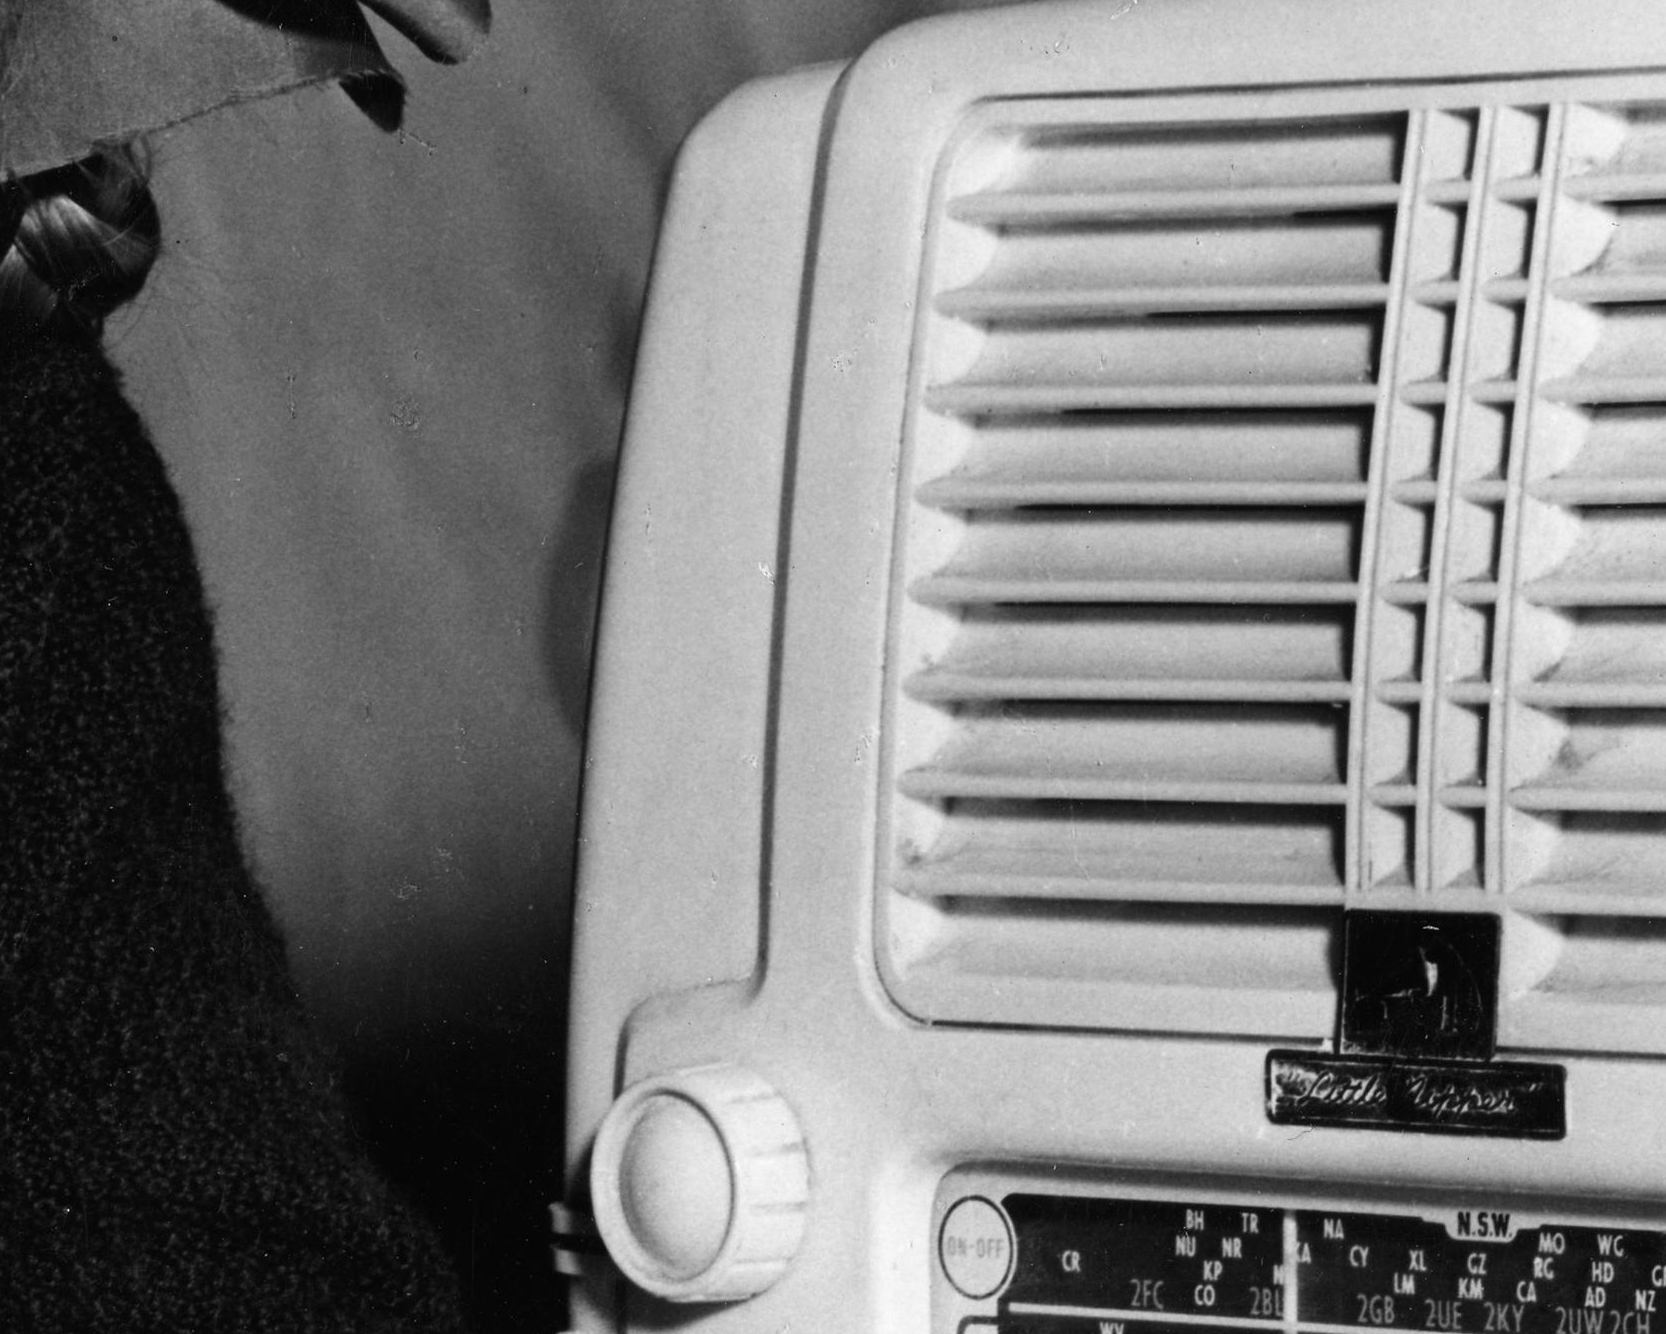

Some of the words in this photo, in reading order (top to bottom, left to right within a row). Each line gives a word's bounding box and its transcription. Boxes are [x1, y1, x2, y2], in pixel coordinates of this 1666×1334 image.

[1186, 1209, 1204, 1231] BH
[1241, 1212, 1259, 1234] TR
[1324, 1219, 1344, 1239] NA
[1457, 1211, 1512, 1239] N.S.W.
[946, 1235, 1004, 1259] ON-OFF
[1175, 1235, 1196, 1257] NU
[1222, 1237, 1242, 1259] NR
[1539, 1233, 1565, 1255] MO
[1597, 1234, 1624, 1257] WG
[1062, 1251, 1081, 1272] CR
[1350, 1245, 1369, 1267] CY
[1409, 1250, 1427, 1272] XL
[1468, 1253, 1487, 1275] GZ
[1203, 1260, 1222, 1281] KP
[1533, 1256, 1554, 1280] RG
[1592, 1261, 1614, 1283] HD
[1394, 1272, 1415, 1294] LM
[1458, 1278, 1484, 1300] KM
[1516, 1281, 1537, 1303] CA
[1130, 1279, 1164, 1310] 2FC
[1195, 1284, 1215, 1306] CO
[1585, 1286, 1606, 1308] AD
[1635, 1289, 1656, 1312] NZ
[1357, 1294, 1394, 1325] 2GB
[1425, 1299, 1462, 1330] 2UE
[1484, 1302, 1525, 1333] 2KY
